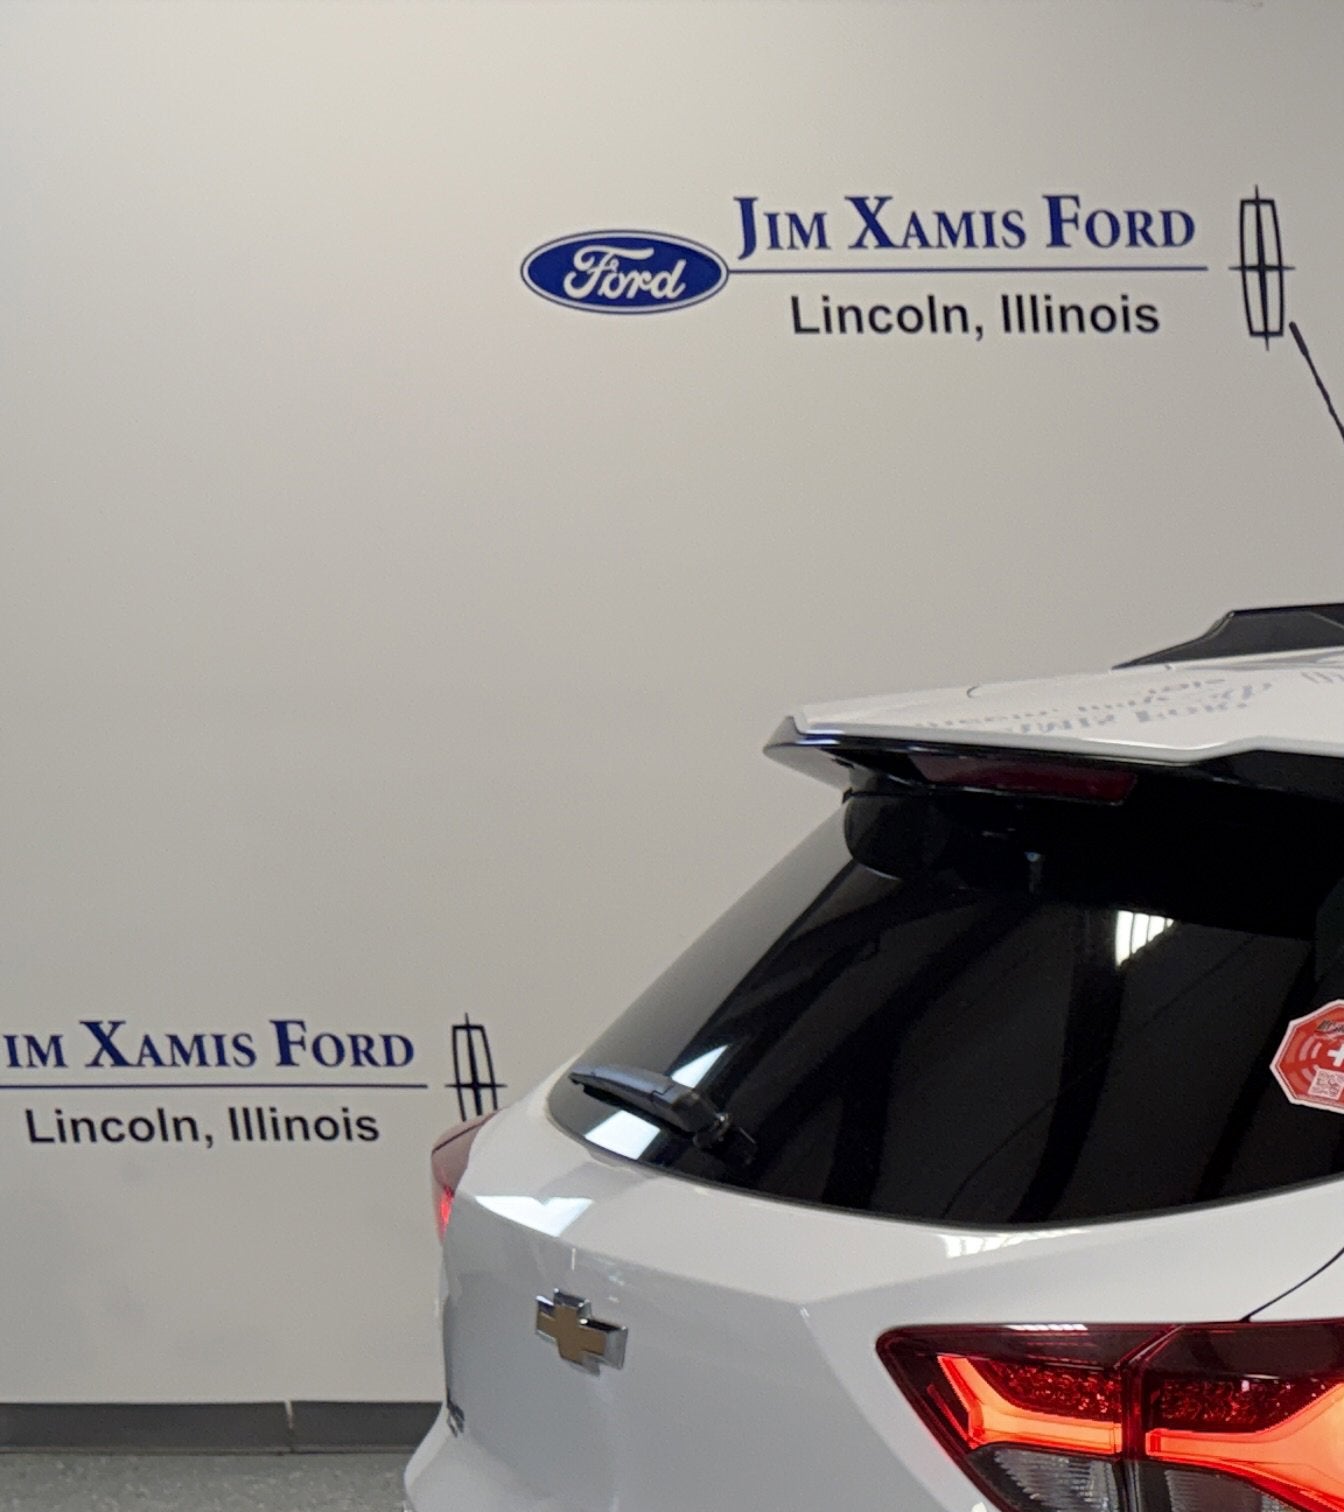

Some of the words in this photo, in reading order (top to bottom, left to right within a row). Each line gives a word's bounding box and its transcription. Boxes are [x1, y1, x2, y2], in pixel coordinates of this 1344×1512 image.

[733, 196, 832, 261] JIM
[844, 195, 1027, 250] XAMIS
[1041, 194, 1196, 249] FORD
[563, 244, 688, 300] Ford
[790, 293, 984, 342] Lincoln,
[1000, 293, 1161, 334] Illinois
[2, 1034, 69, 1069] IM
[79, 1020, 257, 1068] XAMIS
[269, 1019, 415, 1068] FORD
[24, 1107, 214, 1149] Lincoln,
[227, 1106, 380, 1142] Illinois
